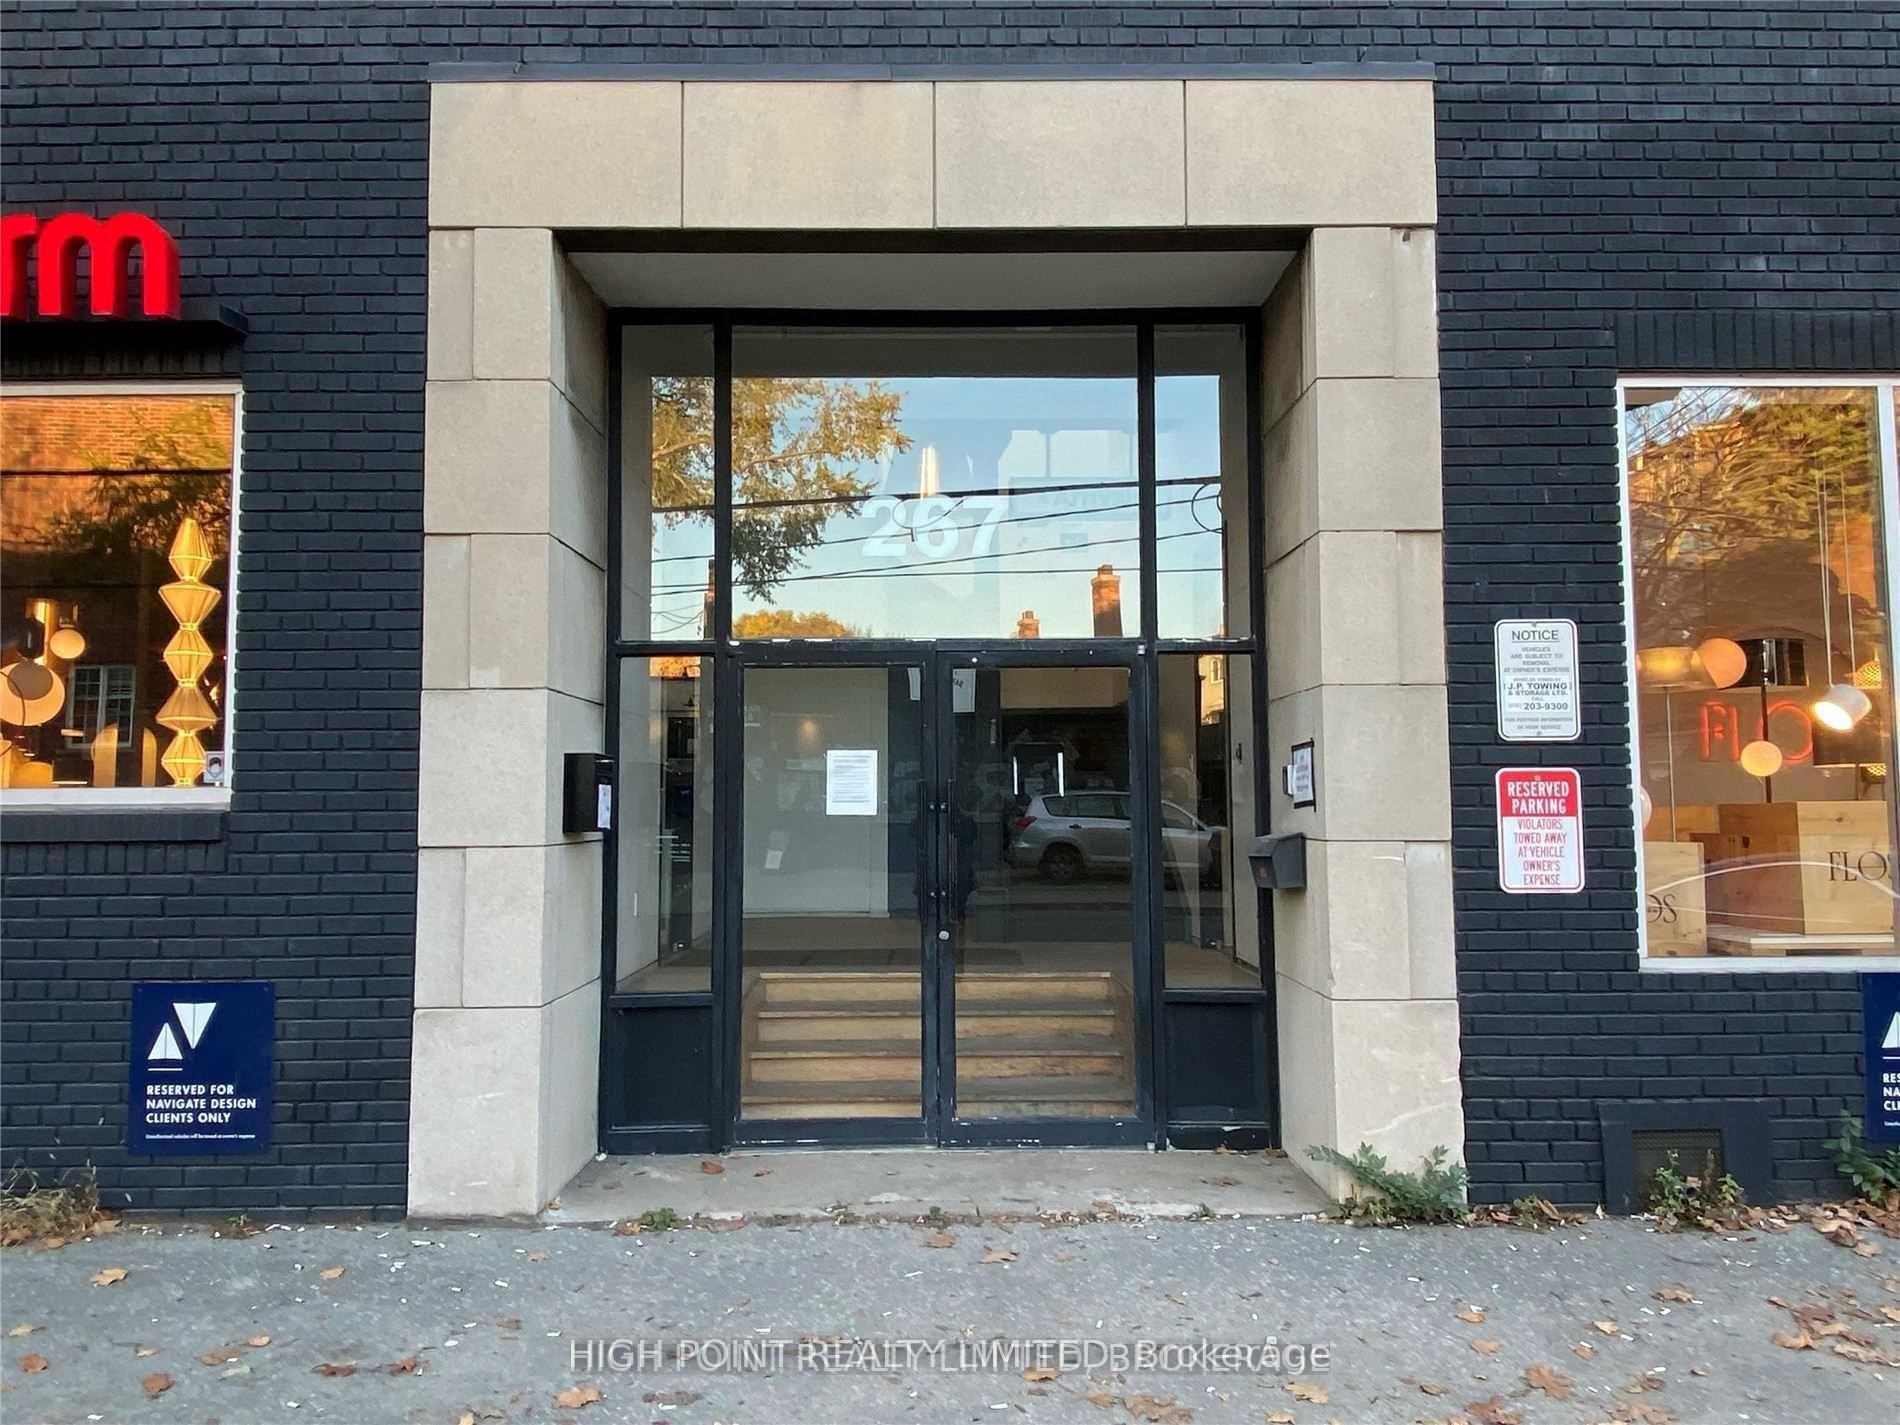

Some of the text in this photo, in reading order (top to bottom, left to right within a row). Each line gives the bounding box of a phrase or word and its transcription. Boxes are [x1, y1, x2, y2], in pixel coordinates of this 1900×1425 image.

[861, 495, 1008, 558] 267
[1511, 630, 1560, 641] NOTICE
[1507, 682, 1568, 690] J.P. TOWING
[1507, 781, 1570, 797] RESERVED
[1512, 798, 1567, 814] PARKING
[1517, 818, 1563, 830] VIOLATORS
[1513, 832, 1568, 844] TOWED AWAY
[1518, 846, 1565, 858] AT VEHICLE
[1523, 860, 1561, 871] OWNER'S
[1523, 874, 1561, 886] EXPENSE
[146, 1084, 234, 1096] RESERVED FOR
[146, 1098, 257, 1109] NAVIGATE DESIGN
[145, 1112, 231, 1123] CLIENTS ONLY
